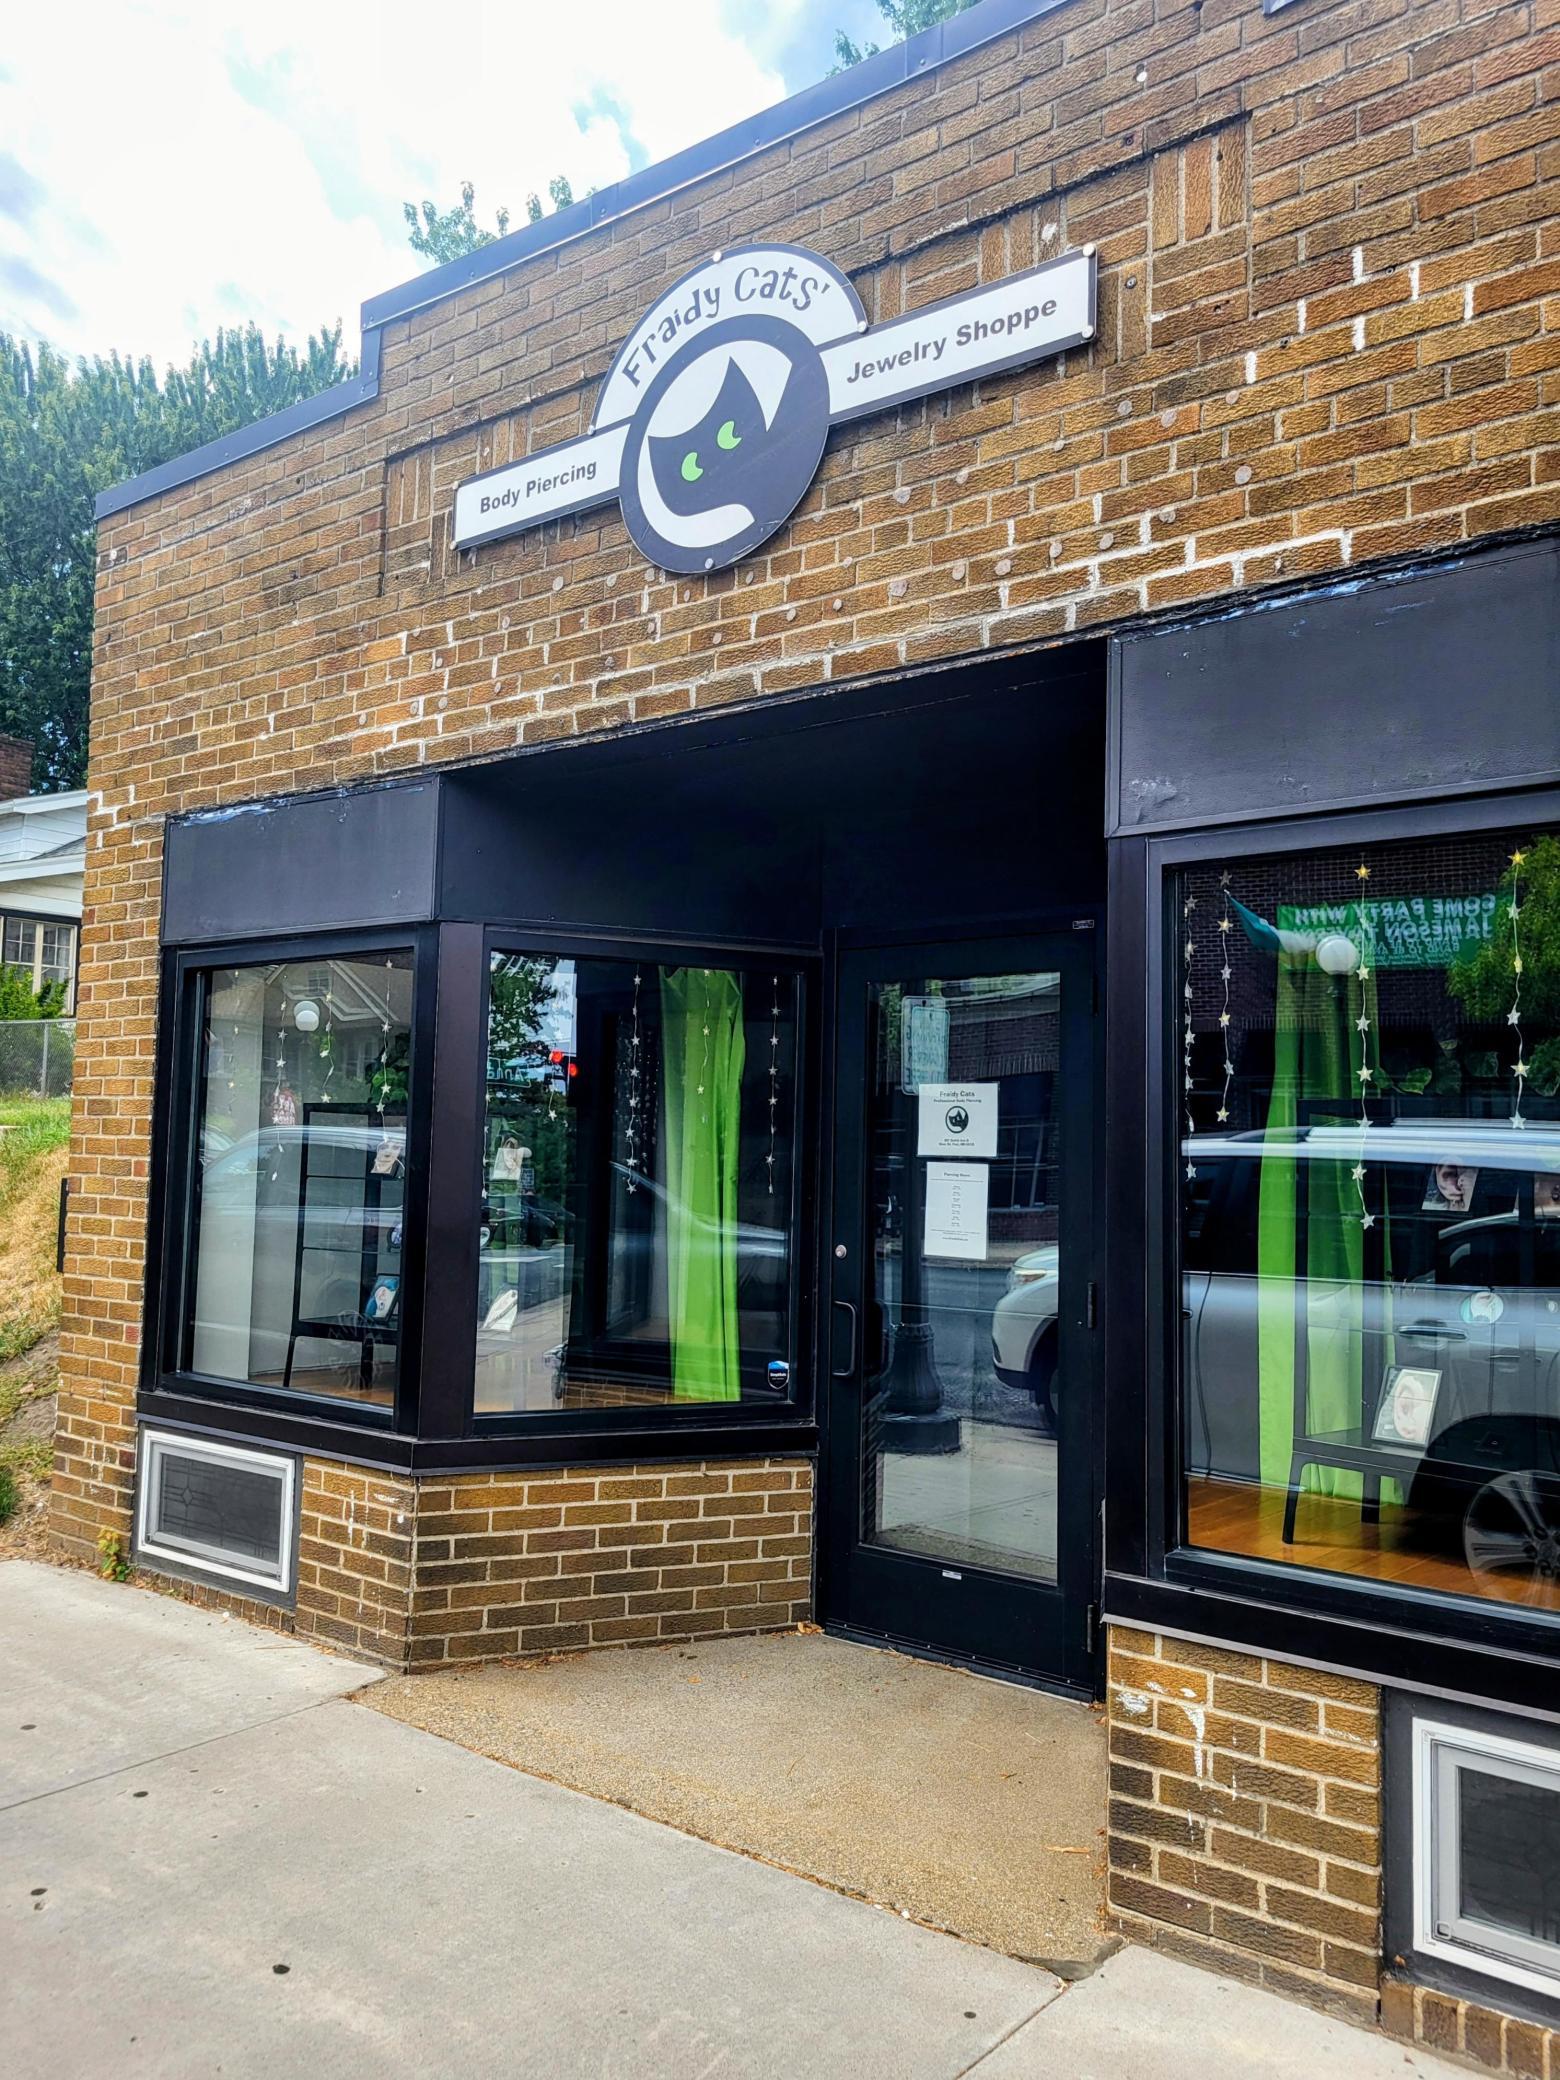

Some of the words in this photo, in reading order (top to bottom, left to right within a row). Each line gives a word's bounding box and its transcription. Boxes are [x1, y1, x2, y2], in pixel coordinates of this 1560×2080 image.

[622, 286, 721, 388] Fraidy
[846, 336, 947, 384] Jewelry
[955, 299, 1057, 347] Shoppe
[480, 489, 520, 514] Body
[526, 461, 597, 498] Piercing
